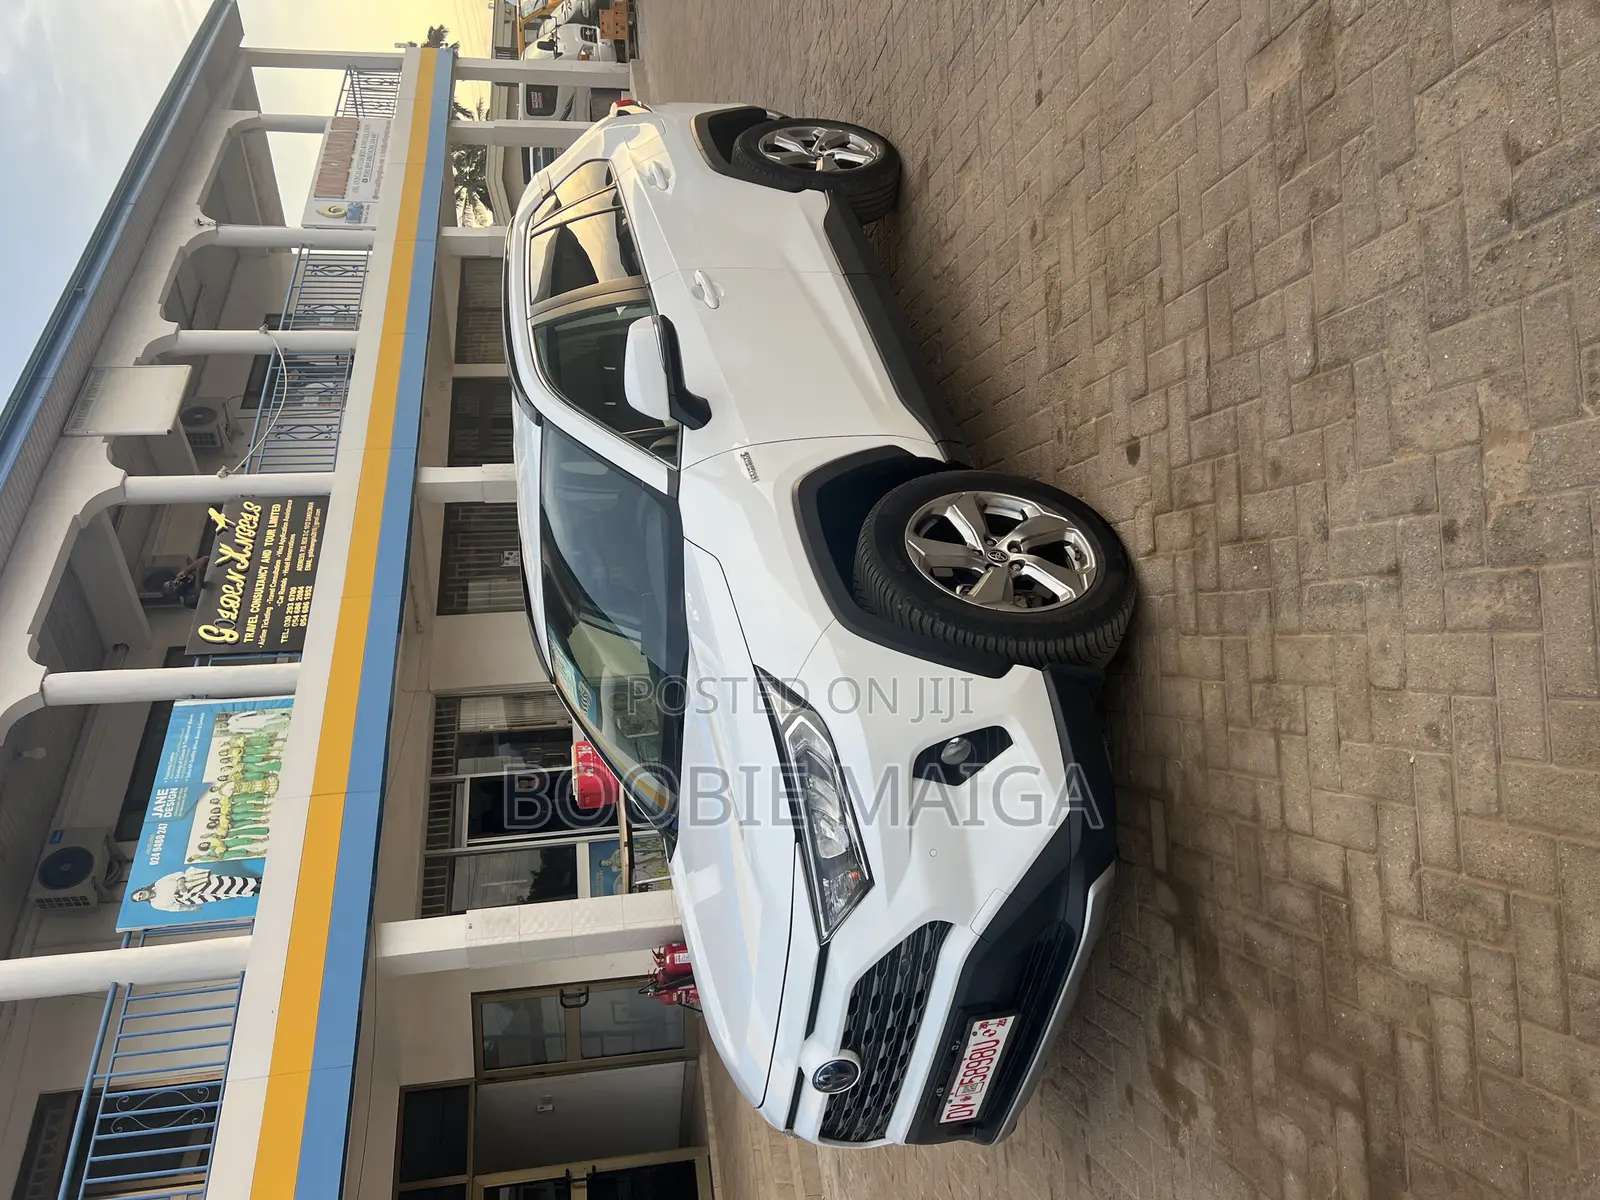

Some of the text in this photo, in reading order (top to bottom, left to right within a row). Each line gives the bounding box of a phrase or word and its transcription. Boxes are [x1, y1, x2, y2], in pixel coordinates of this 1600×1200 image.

[243, 504, 281, 643] TRAVEL CONSULTANCY AND TOUR LIMITED
[258, 500, 293, 645] Airline Ticketing Travel Consultation Visa Application Assistance
[276, 534, 296, 604] Car Rentals Hotel Reservations
[283, 616, 292, 627] 030
[286, 603, 294, 614] 293
[291, 615, 300, 627] 054
[300, 614, 308, 626] 054
[281, 628, 289, 643] TEL:
[152, 788, 169, 818] JANE
[163, 788, 178, 818] DESIGN
[149, 853, 160, 865] 024
[157, 824, 168, 834] 247
[946, 1040, 1000, 1119] DV 5898U
